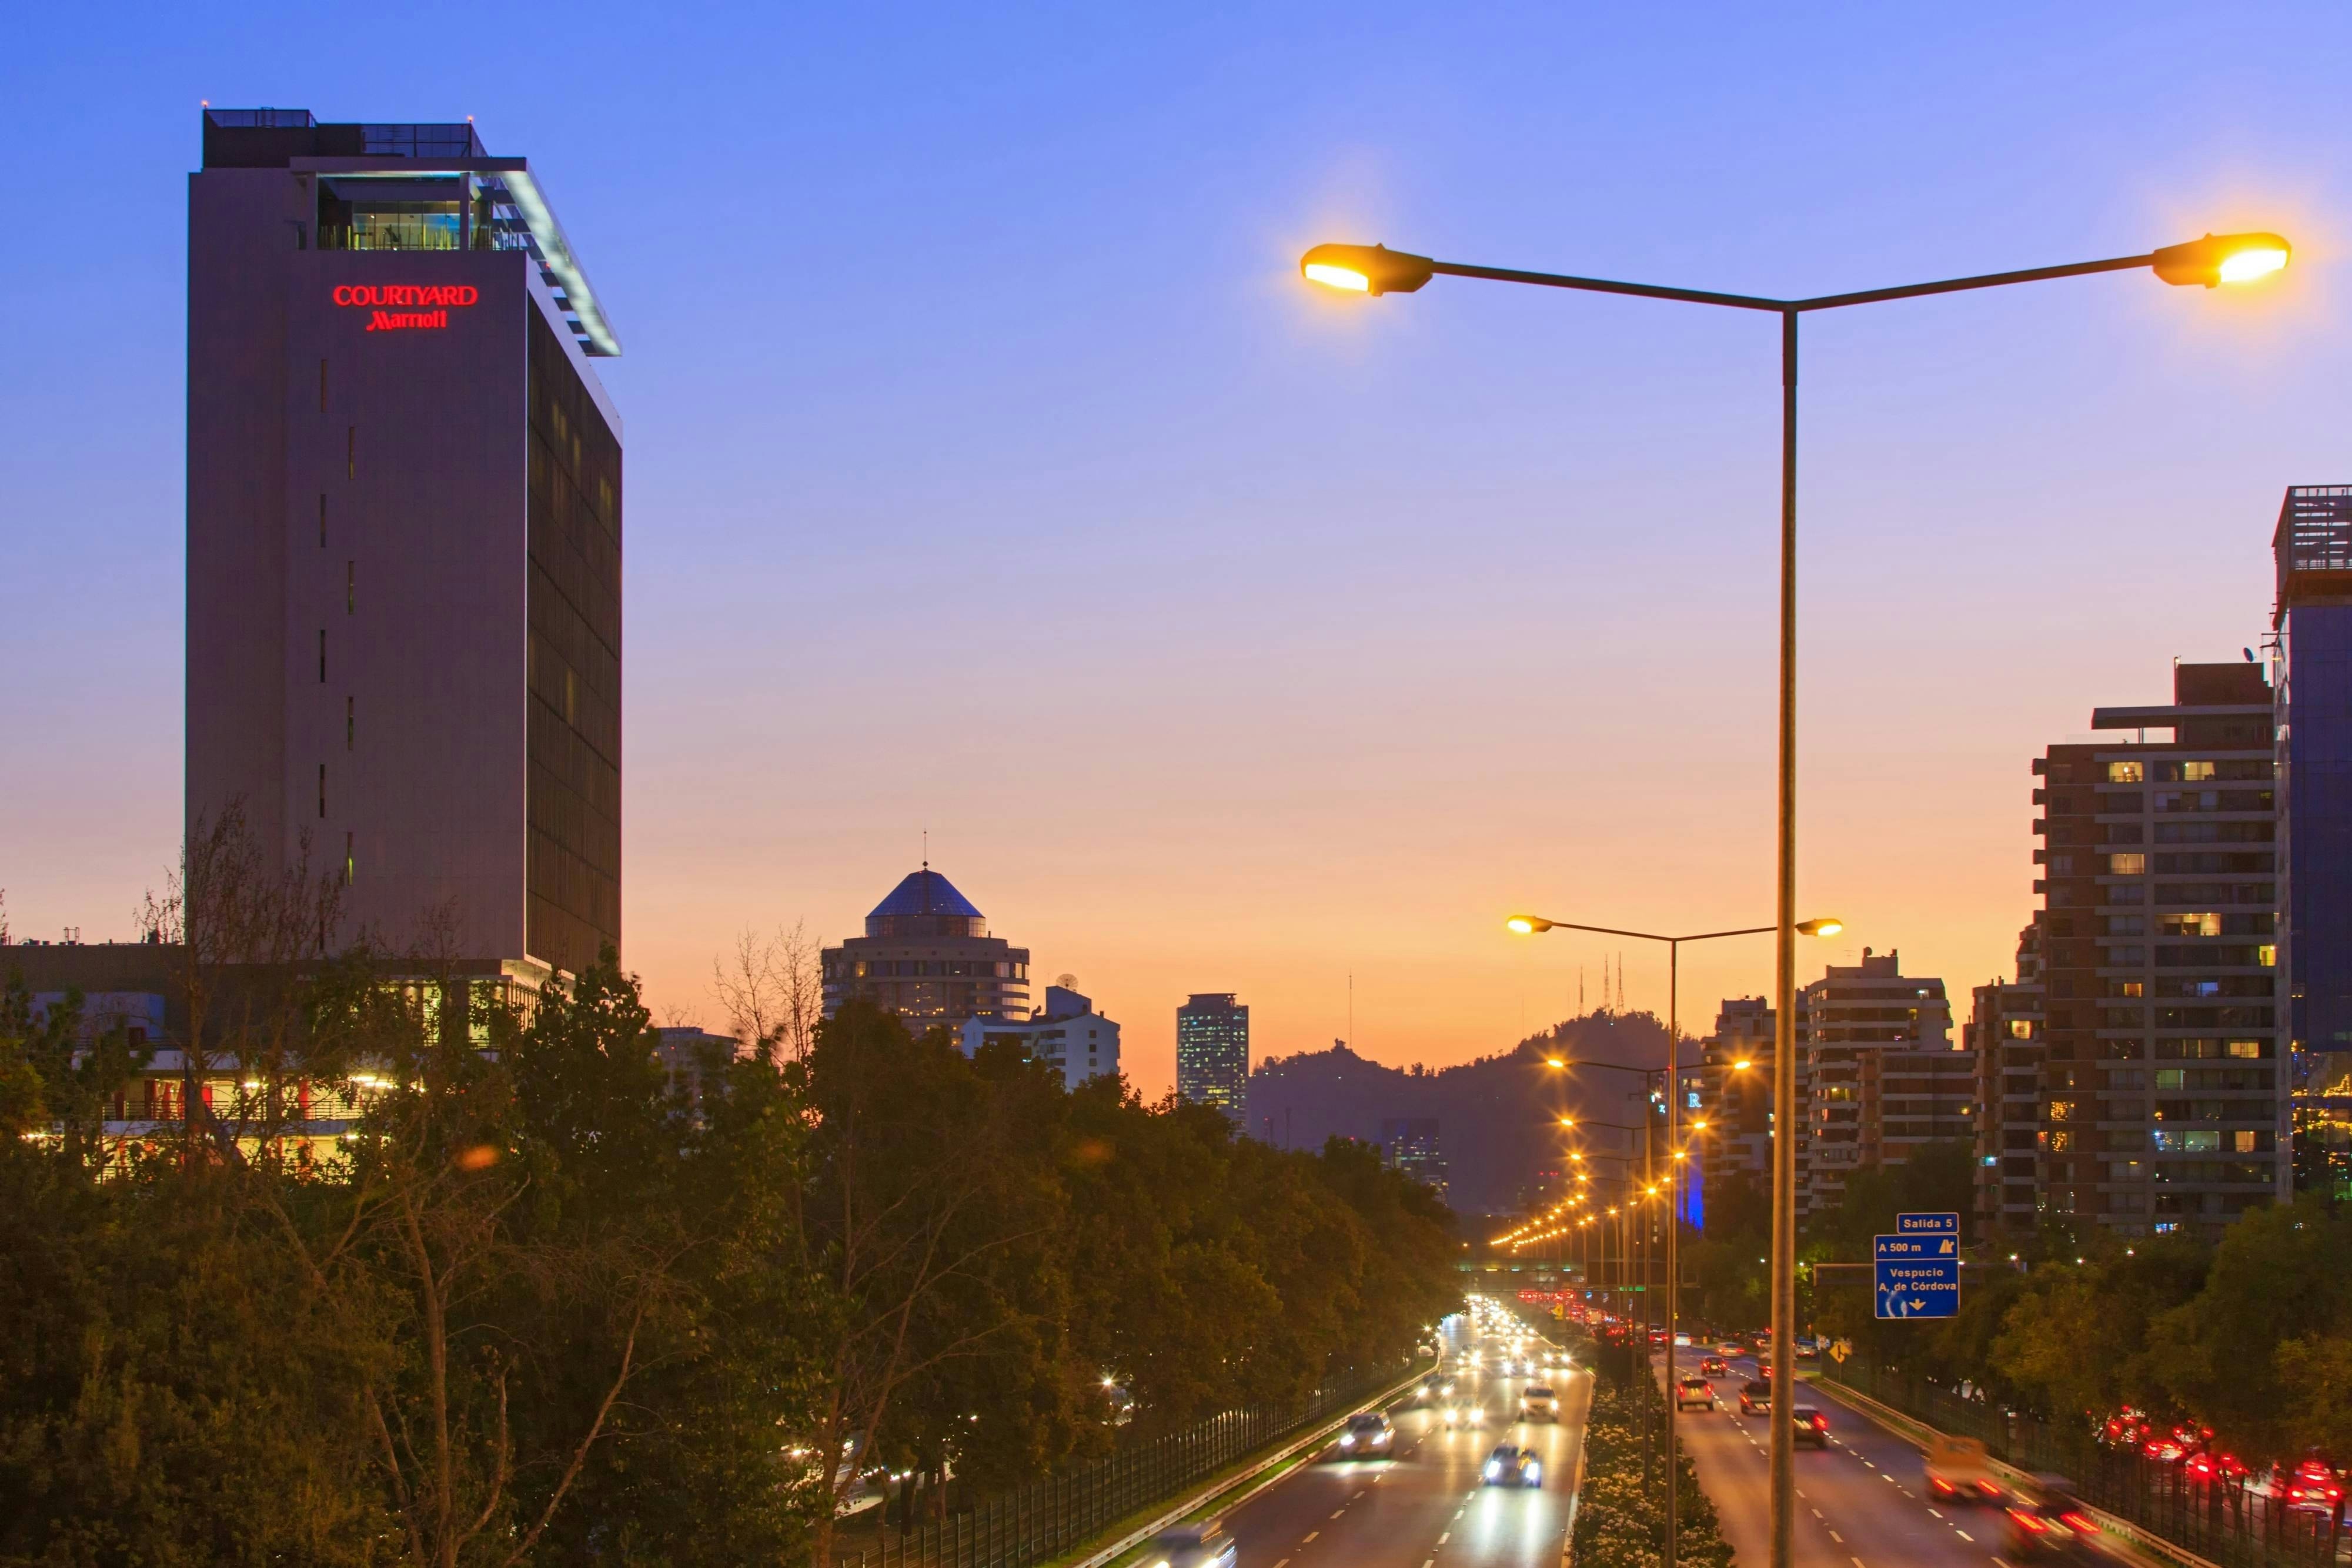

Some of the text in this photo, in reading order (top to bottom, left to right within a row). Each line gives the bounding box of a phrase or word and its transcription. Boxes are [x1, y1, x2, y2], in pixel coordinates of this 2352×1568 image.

[333, 286, 477, 306] COURTYARD
[366, 310, 447, 331] Marriott
[1904, 1219, 1953, 1228] Salida 5
[1879, 1243, 1886, 1252] A
[1890, 1243, 1908, 1252] 500
[1890, 1268, 1943, 1278] Vespucio
[1894, 1282, 1907, 1291] de
[1911, 1282, 1957, 1291] Córdova
